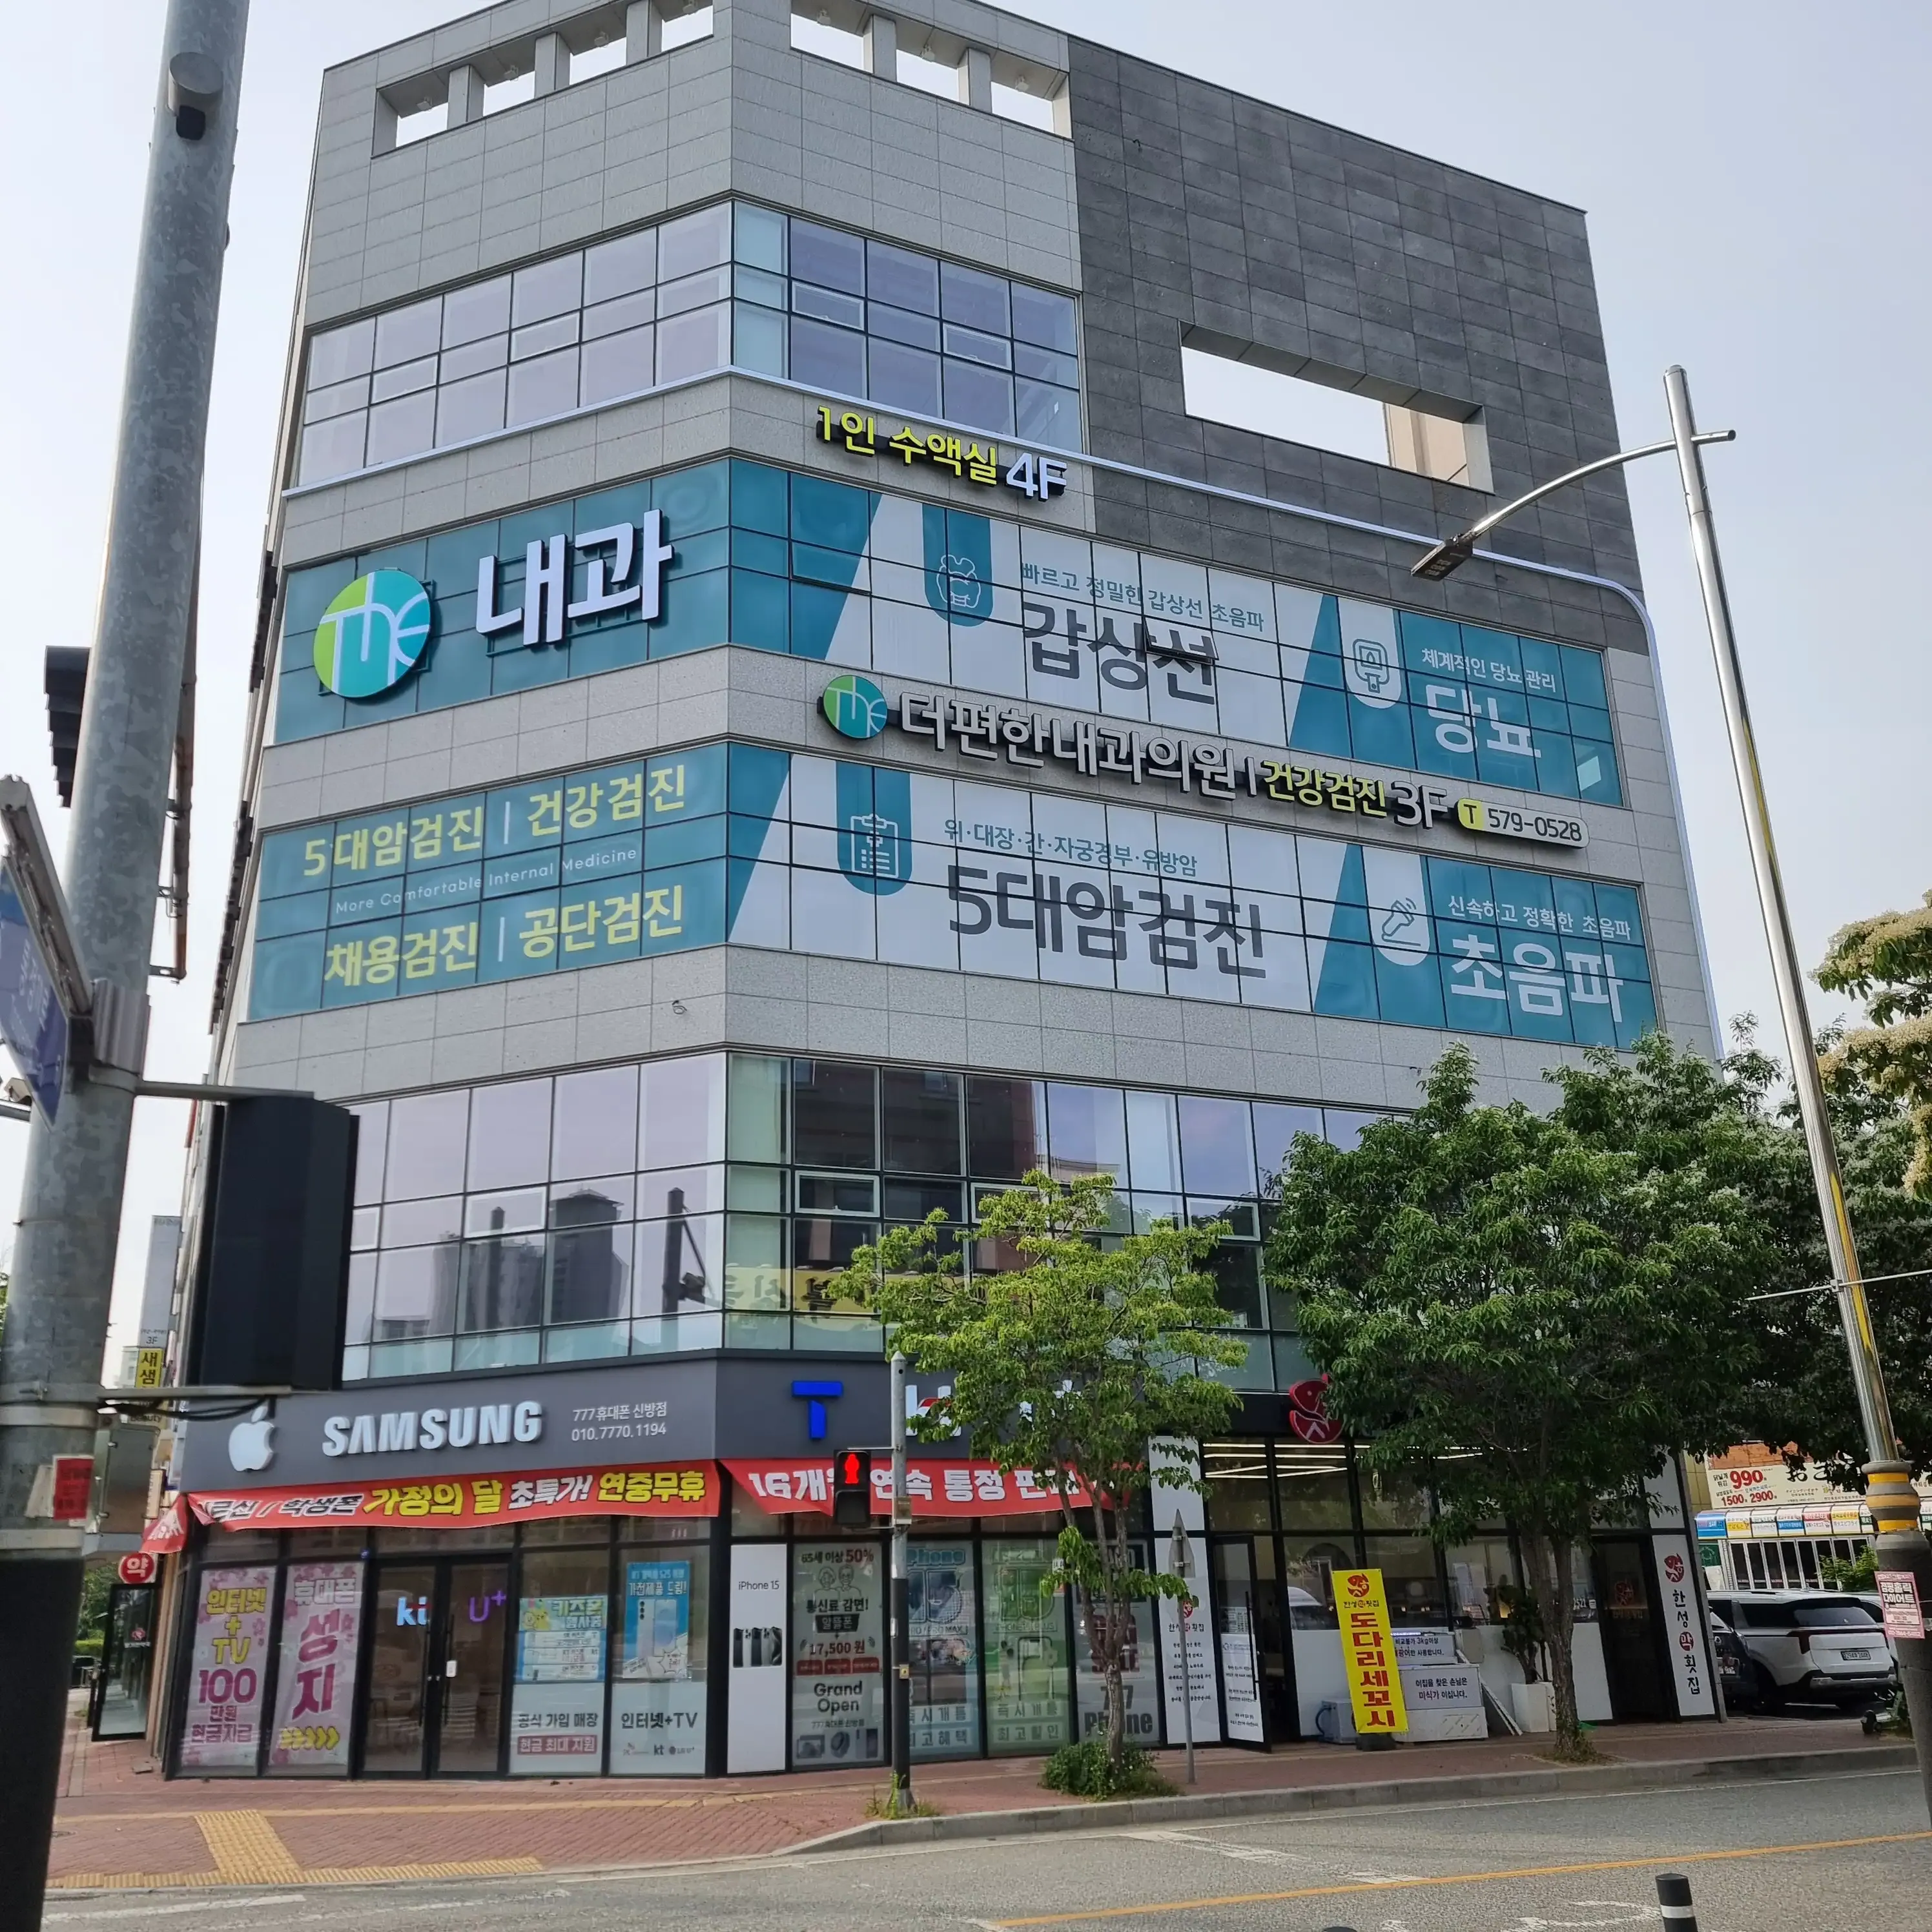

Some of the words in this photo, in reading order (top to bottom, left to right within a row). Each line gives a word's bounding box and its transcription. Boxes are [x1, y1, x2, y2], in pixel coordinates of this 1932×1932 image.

[817, 406, 875, 456] 1인
[889, 426, 998, 486] 수액실
[1005, 452, 1067, 502] 4F
[476, 509, 675, 646] 내과
[1022, 562, 1080, 592] 빠르고
[1085, 576, 1141, 607] 정밀한
[1148, 590, 1203, 620] 갑상선
[1211, 603, 1264, 632] 초음파
[1023, 601, 1215, 705] 갑상선
[1422, 648, 1486, 679] 체계적인
[1489, 662, 1523, 684] 당뇨
[1525, 669, 1556, 693] 관리
[1426, 684, 1542, 759] 당뇨
[901, 691, 1237, 801] 더편한내과의원
[1261, 760, 1387, 819] 건강검진
[1391, 781, 1449, 830] 3F
[527, 765, 686, 838] 건강검진
[1463, 803, 1479, 826] T
[1488, 808, 1583, 842] 579-0528
[336, 898, 374, 914] More
[380, 878, 482, 906] Comfortable
[488, 862, 554, 887] Internal
[561, 847, 637, 872] Medicine
[947, 864, 1267, 979] 5대암검진
[1448, 895, 1518, 923] 신속하고
[1523, 905, 1574, 933] 정확한
[1582, 914, 1632, 941] 초음파
[324, 921, 478, 987] 채용검진
[519, 885, 683, 959] 공단검진
[1450, 933, 1625, 1023] 초음파
[572, 1404, 631, 1423] 777휴대폰
[632, 1401, 668, 1419] 신방점
[322, 1399, 543, 1457] SAMSUNG
[571, 1422, 667, 1442] 010.7770.1194
[362, 1483, 464, 1517] 가정의
[472, 1480, 504, 1516] 달
[597, 1470, 706, 1503] 연중무휴
[748, 1467, 834, 1502] 16개
[869, 1468, 932, 1502] 연속
[943, 1469, 1006, 1503] 통정
[1730, 1470, 1764, 1490] 990
[1721, 1494, 1745, 1507] 1500
[1749, 1490, 1774, 1503] 2900
[127, 1558, 149, 1578] 약
[845, 1548, 874, 1563] 50%
[293, 1578, 356, 1607] 휴대폰
[738, 1581, 769, 1590] iPhone
[770, 1580, 780, 1590] 15
[205, 1587, 267, 1615] 인터넷
[843, 1598, 869, 1612] 감면!
[211, 1636, 252, 1665] TV
[809, 1642, 852, 1656] 17,500
[854, 1639, 866, 1654] 원
[198, 1667, 258, 1705] 100
[813, 1680, 863, 1698] Grand
[209, 1704, 238, 1723] 만원
[517, 1713, 541, 1728] 공식
[546, 1713, 571, 1729] 가입
[573, 1712, 598, 1728] 매장
[621, 1712, 698, 1730] 인터넷+TV
[817, 1697, 860, 1716] Open
[1084, 1711, 1153, 1735] Phne
[519, 1736, 542, 1752] 현금
[545, 1736, 570, 1752] 최대
[572, 1734, 595, 1752] 지원
